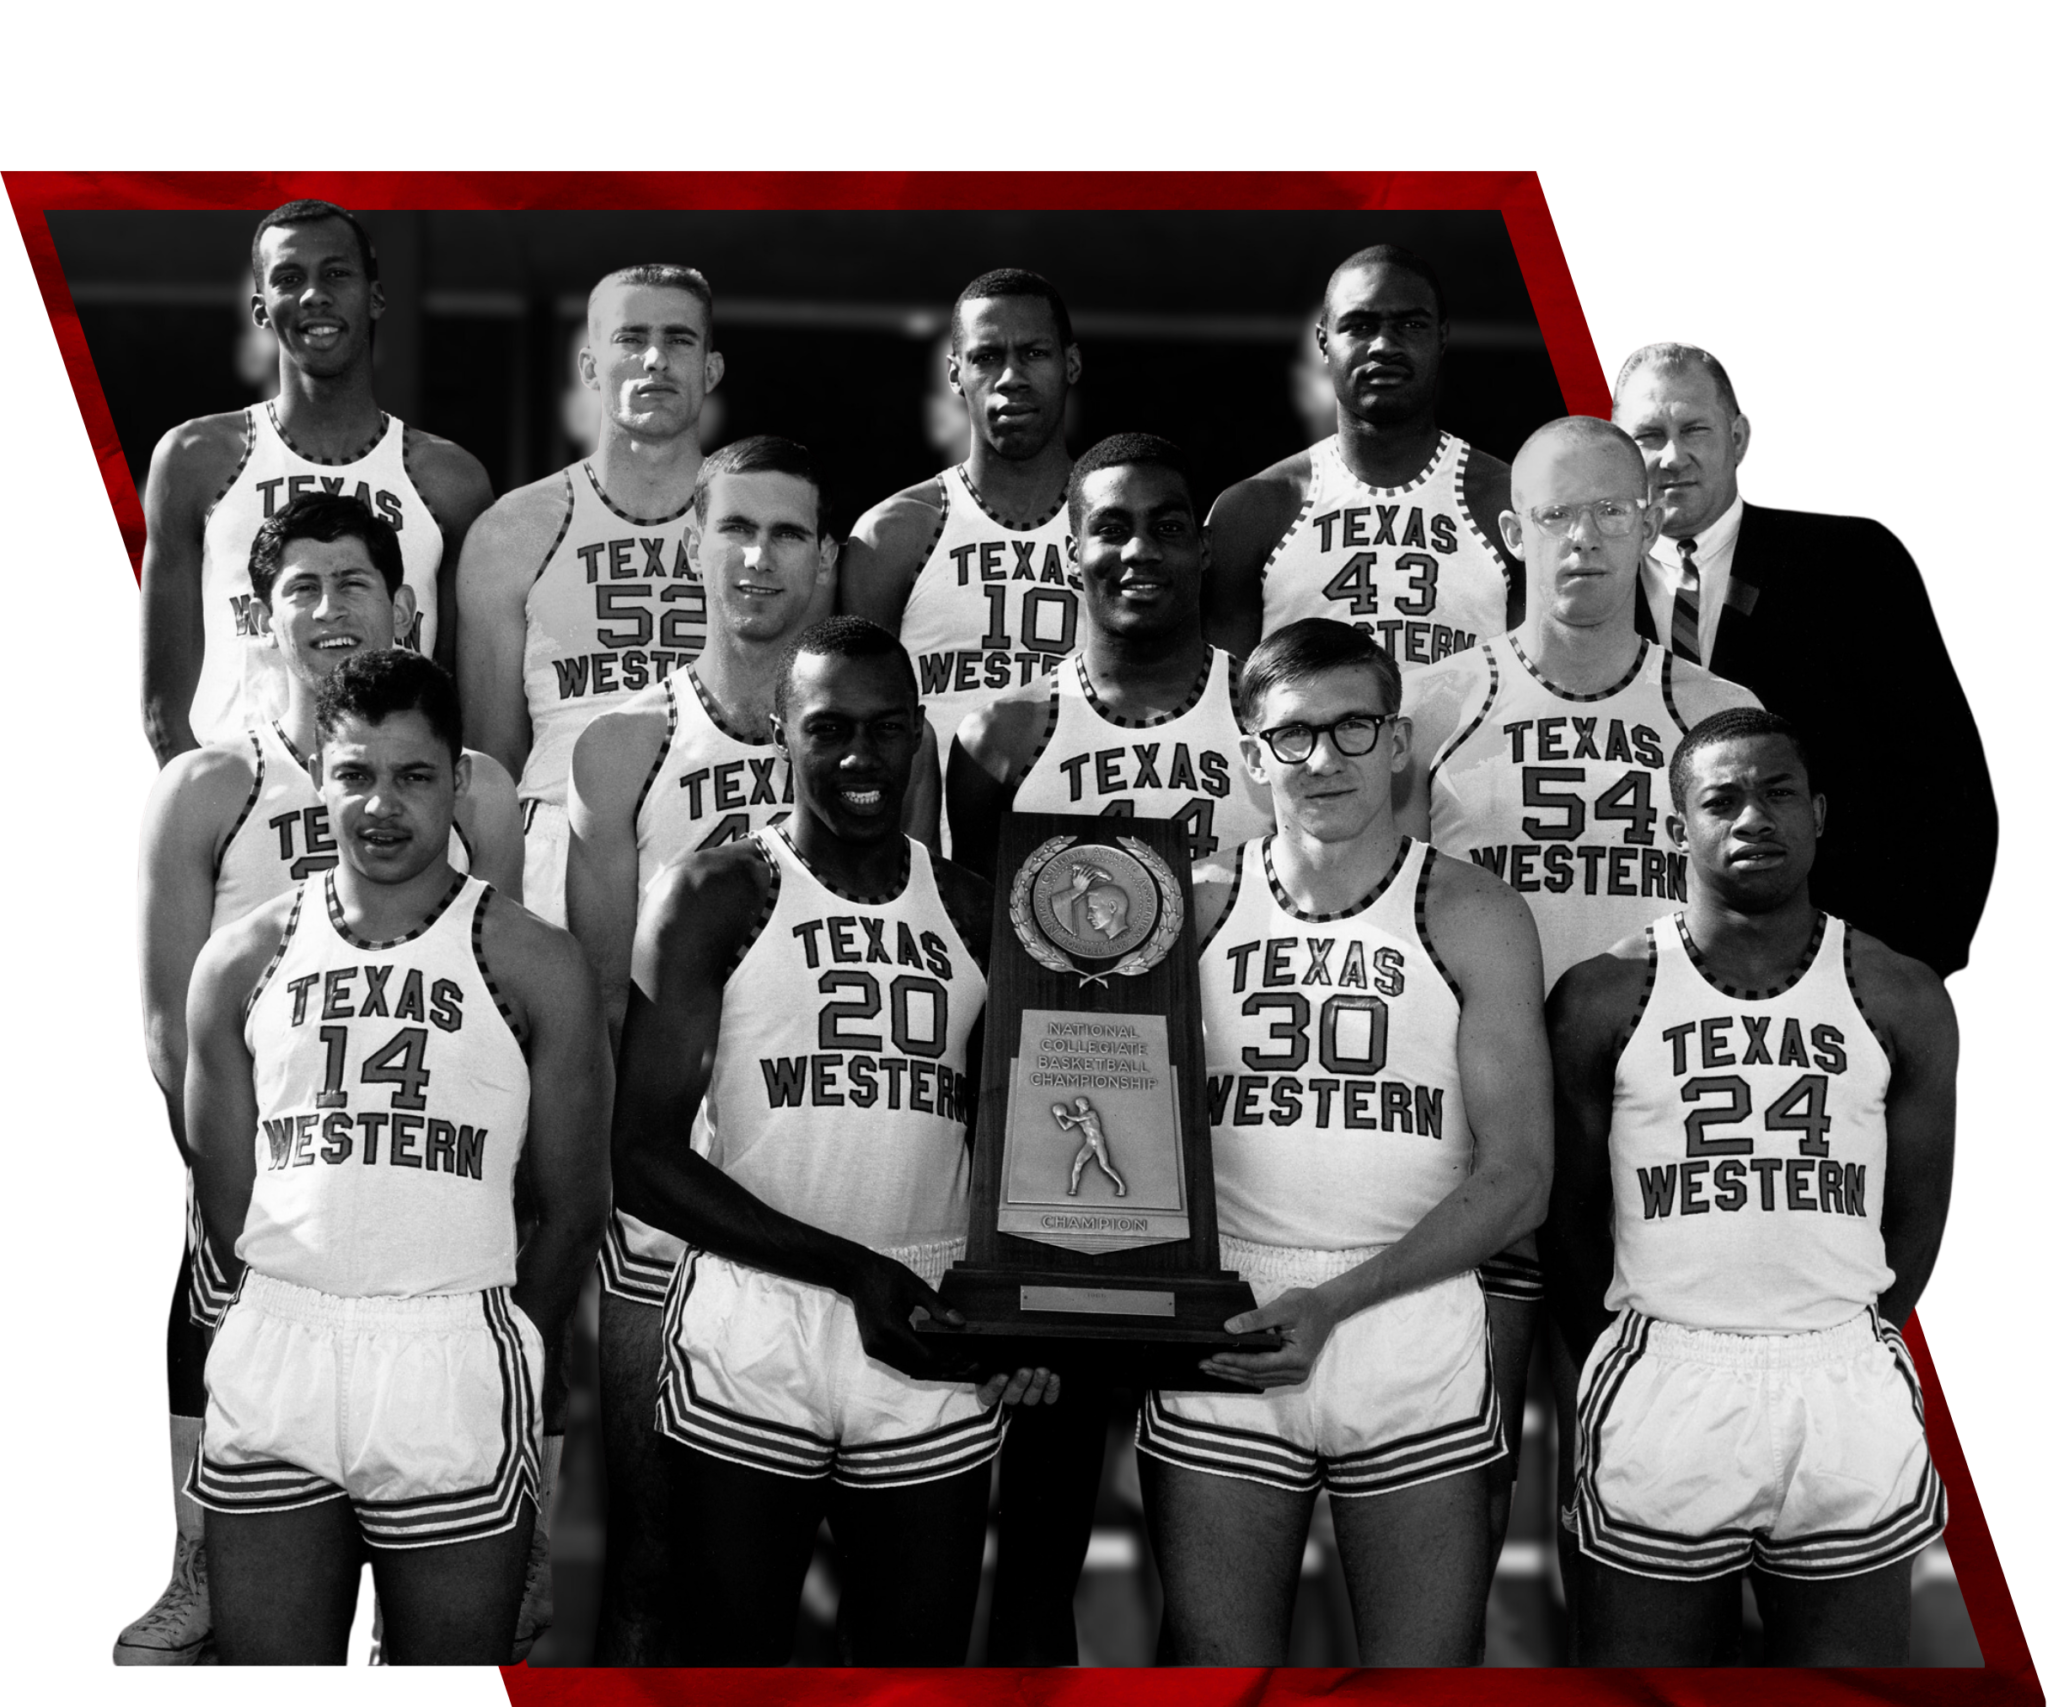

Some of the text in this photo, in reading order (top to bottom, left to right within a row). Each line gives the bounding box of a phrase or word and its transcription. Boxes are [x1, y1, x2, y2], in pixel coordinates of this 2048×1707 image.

[577, 538, 704, 584] TEXA
[1313, 505, 1457, 555] TEXAS
[1322, 552, 1438, 617] 43
[596, 584, 708, 650] 52
[982, 584, 1079, 655] 10
[1060, 743, 1230, 801] TEXAS
[1504, 717, 1664, 769] TEXAS
[1522, 766, 1658, 846] 54
[1469, 844, 1688, 903] WESTERN
[793, 916, 952, 980] TEXAS
[1227, 937, 1404, 997] TEXAS
[287, 965, 464, 1033] TEXAS
[818, 970, 948, 1058] 20
[1048, 1022, 1138, 1038] NATIONAL
[1038, 1056, 1149, 1073] BASKETBALL
[1041, 1039, 1148, 1056] COLLEGIATE
[1242, 992, 1388, 1075] 30
[1662, 1015, 1847, 1076] TEXAS
[316, 1026, 430, 1111] 14
[760, 1053, 968, 1127] WESTERN
[1030, 1073, 1157, 1090] CHAMPIONSHIP
[1207, 1075, 1444, 1140] WESTERN
[1680, 1074, 1831, 1158] 24
[262, 1112, 488, 1181] WESTERN
[1636, 1158, 1867, 1220] WESTERN
[1041, 1214, 1147, 1232] CHAMPION
